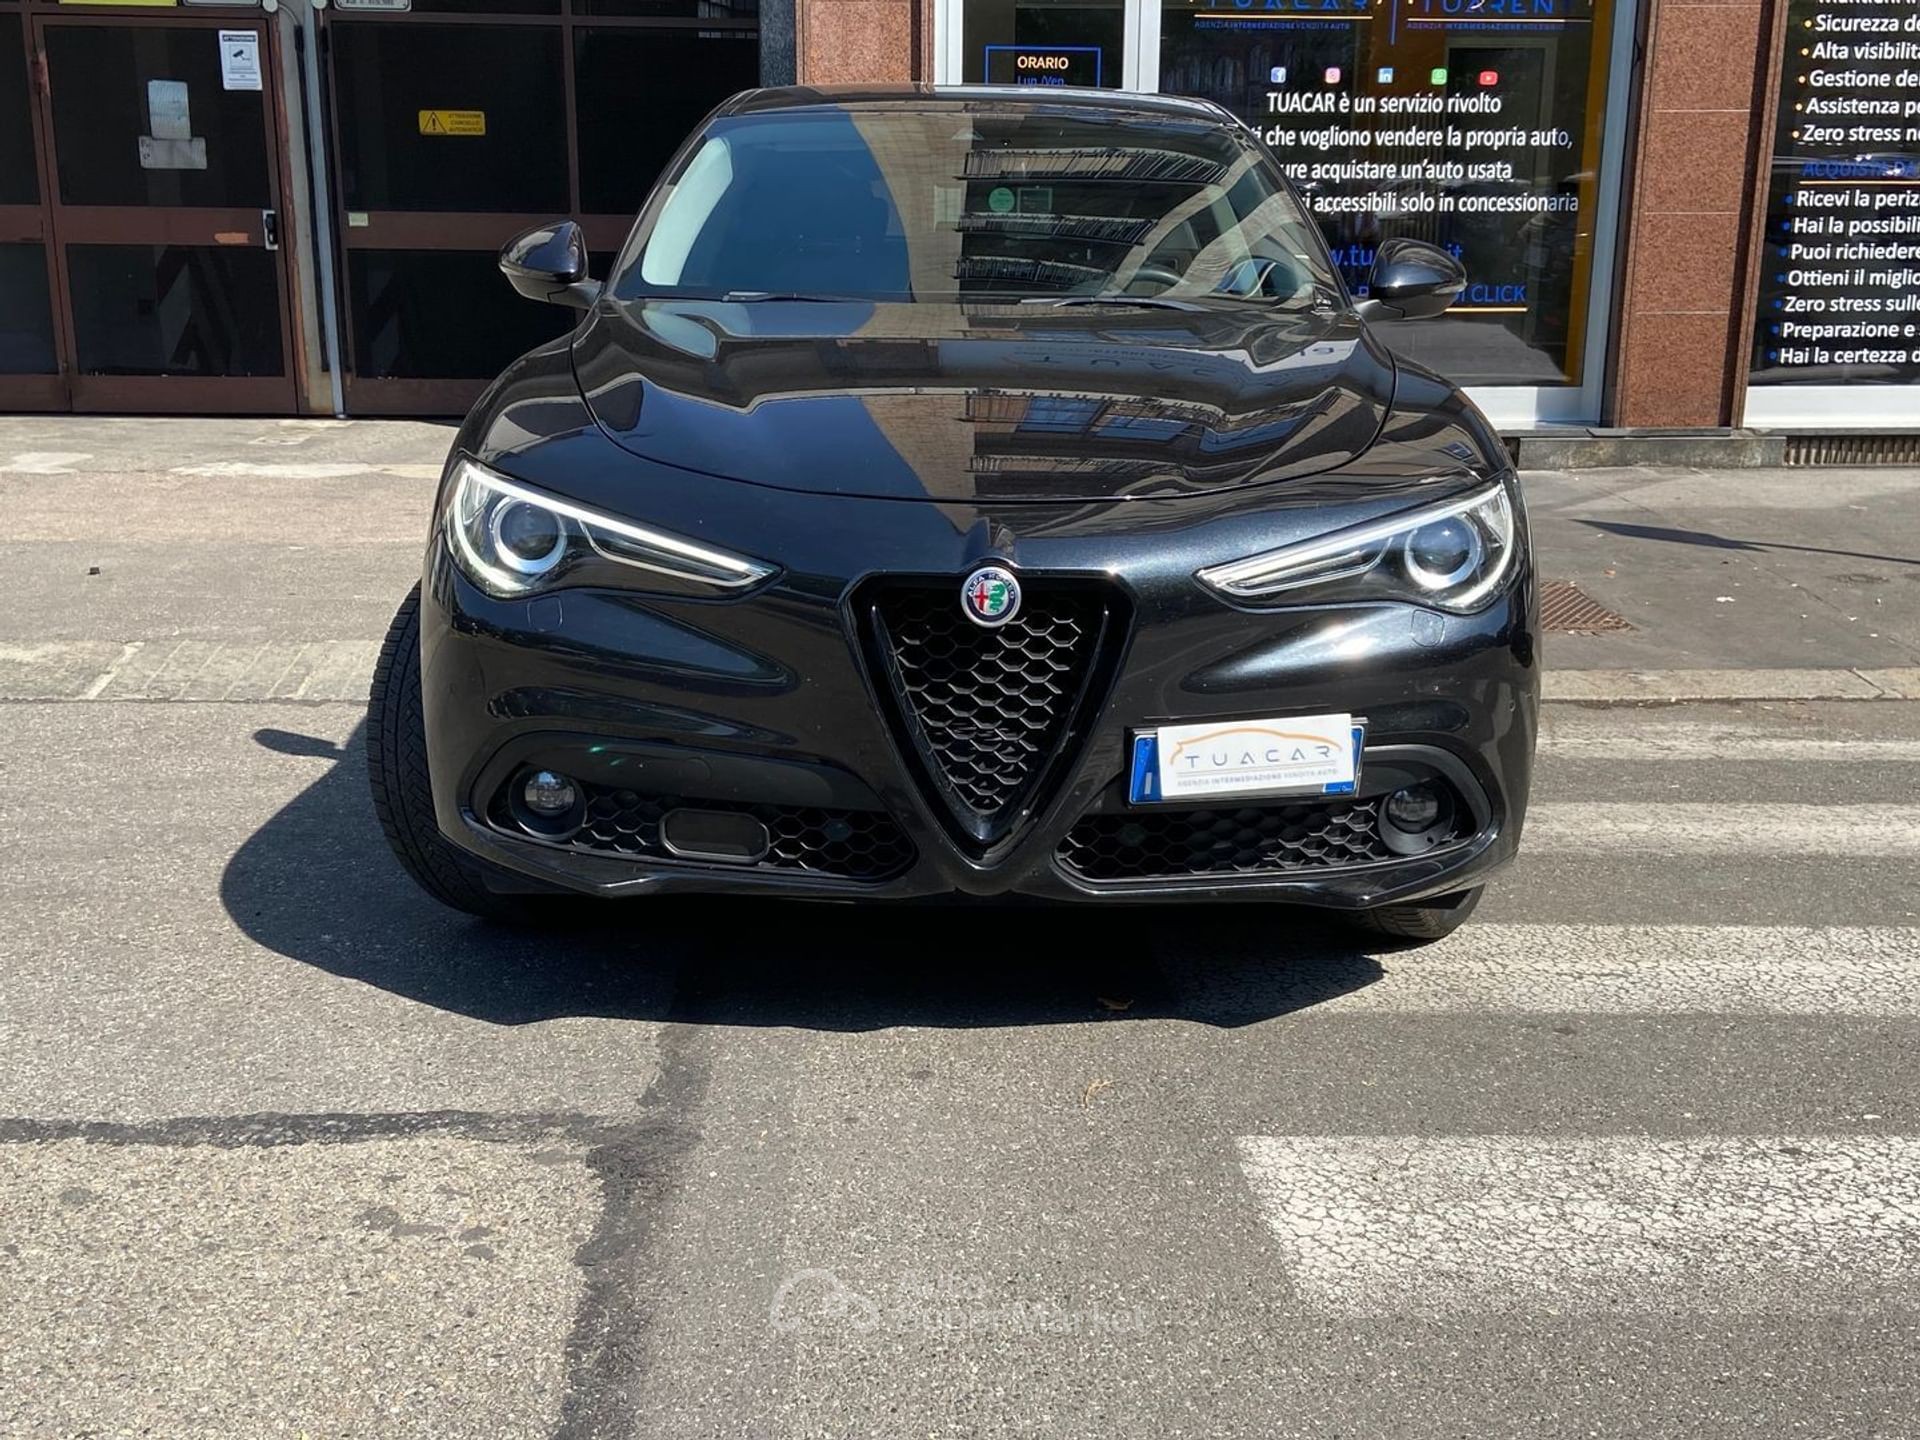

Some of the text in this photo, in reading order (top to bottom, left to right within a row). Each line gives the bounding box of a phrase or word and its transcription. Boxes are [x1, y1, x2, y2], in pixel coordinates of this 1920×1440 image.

[1815, 14, 1899, 32] Sicurezza
[1812, 42, 1848, 59] Alta
[1017, 55, 1069, 69] ORARIO
[1810, 69, 1920, 87] Gestione de
[1266, 91, 1502, 113] TUACAR è un servizio rivolto
[1805, 97, 1900, 115] Assistenza
[1266, 124, 1296, 146] che
[1300, 125, 1371, 151] vogliono
[1375, 125, 1443, 146] vendere
[1447, 125, 1462, 146] la
[1465, 126, 1527, 151] propria
[1530, 128, 1573, 150] auto,
[1803, 124, 1844, 141] Zero
[1849, 126, 1901, 142] stress
[1311, 159, 1396, 183] acquistare
[1401, 158, 1464, 179] un'auto
[1468, 161, 1512, 179] usata
[1314, 192, 1397, 212] accessibili
[1400, 192, 1435, 212] solo
[1439, 193, 1458, 212] in
[1458, 193, 1579, 212] concessionaria
[1797, 189, 1920, 210] Ricevi la periz
[1794, 216, 1823, 233] Hai
[1828, 216, 1844, 233] la
[1791, 243, 1831, 260] Puoi
[1788, 269, 1849, 286] Ottieni
[1854, 269, 1865, 286] il
[1471, 285, 1526, 302] CLICK
[1784, 295, 1826, 312] Zero
[1830, 297, 1882, 312] stress
[1782, 321, 1916, 341] Preparazione e
[1780, 347, 1809, 363] Hai
[1814, 347, 1830, 363] la
[1834, 348, 1907, 363] certezza
[1185, 745, 1330, 768] TUACAR
